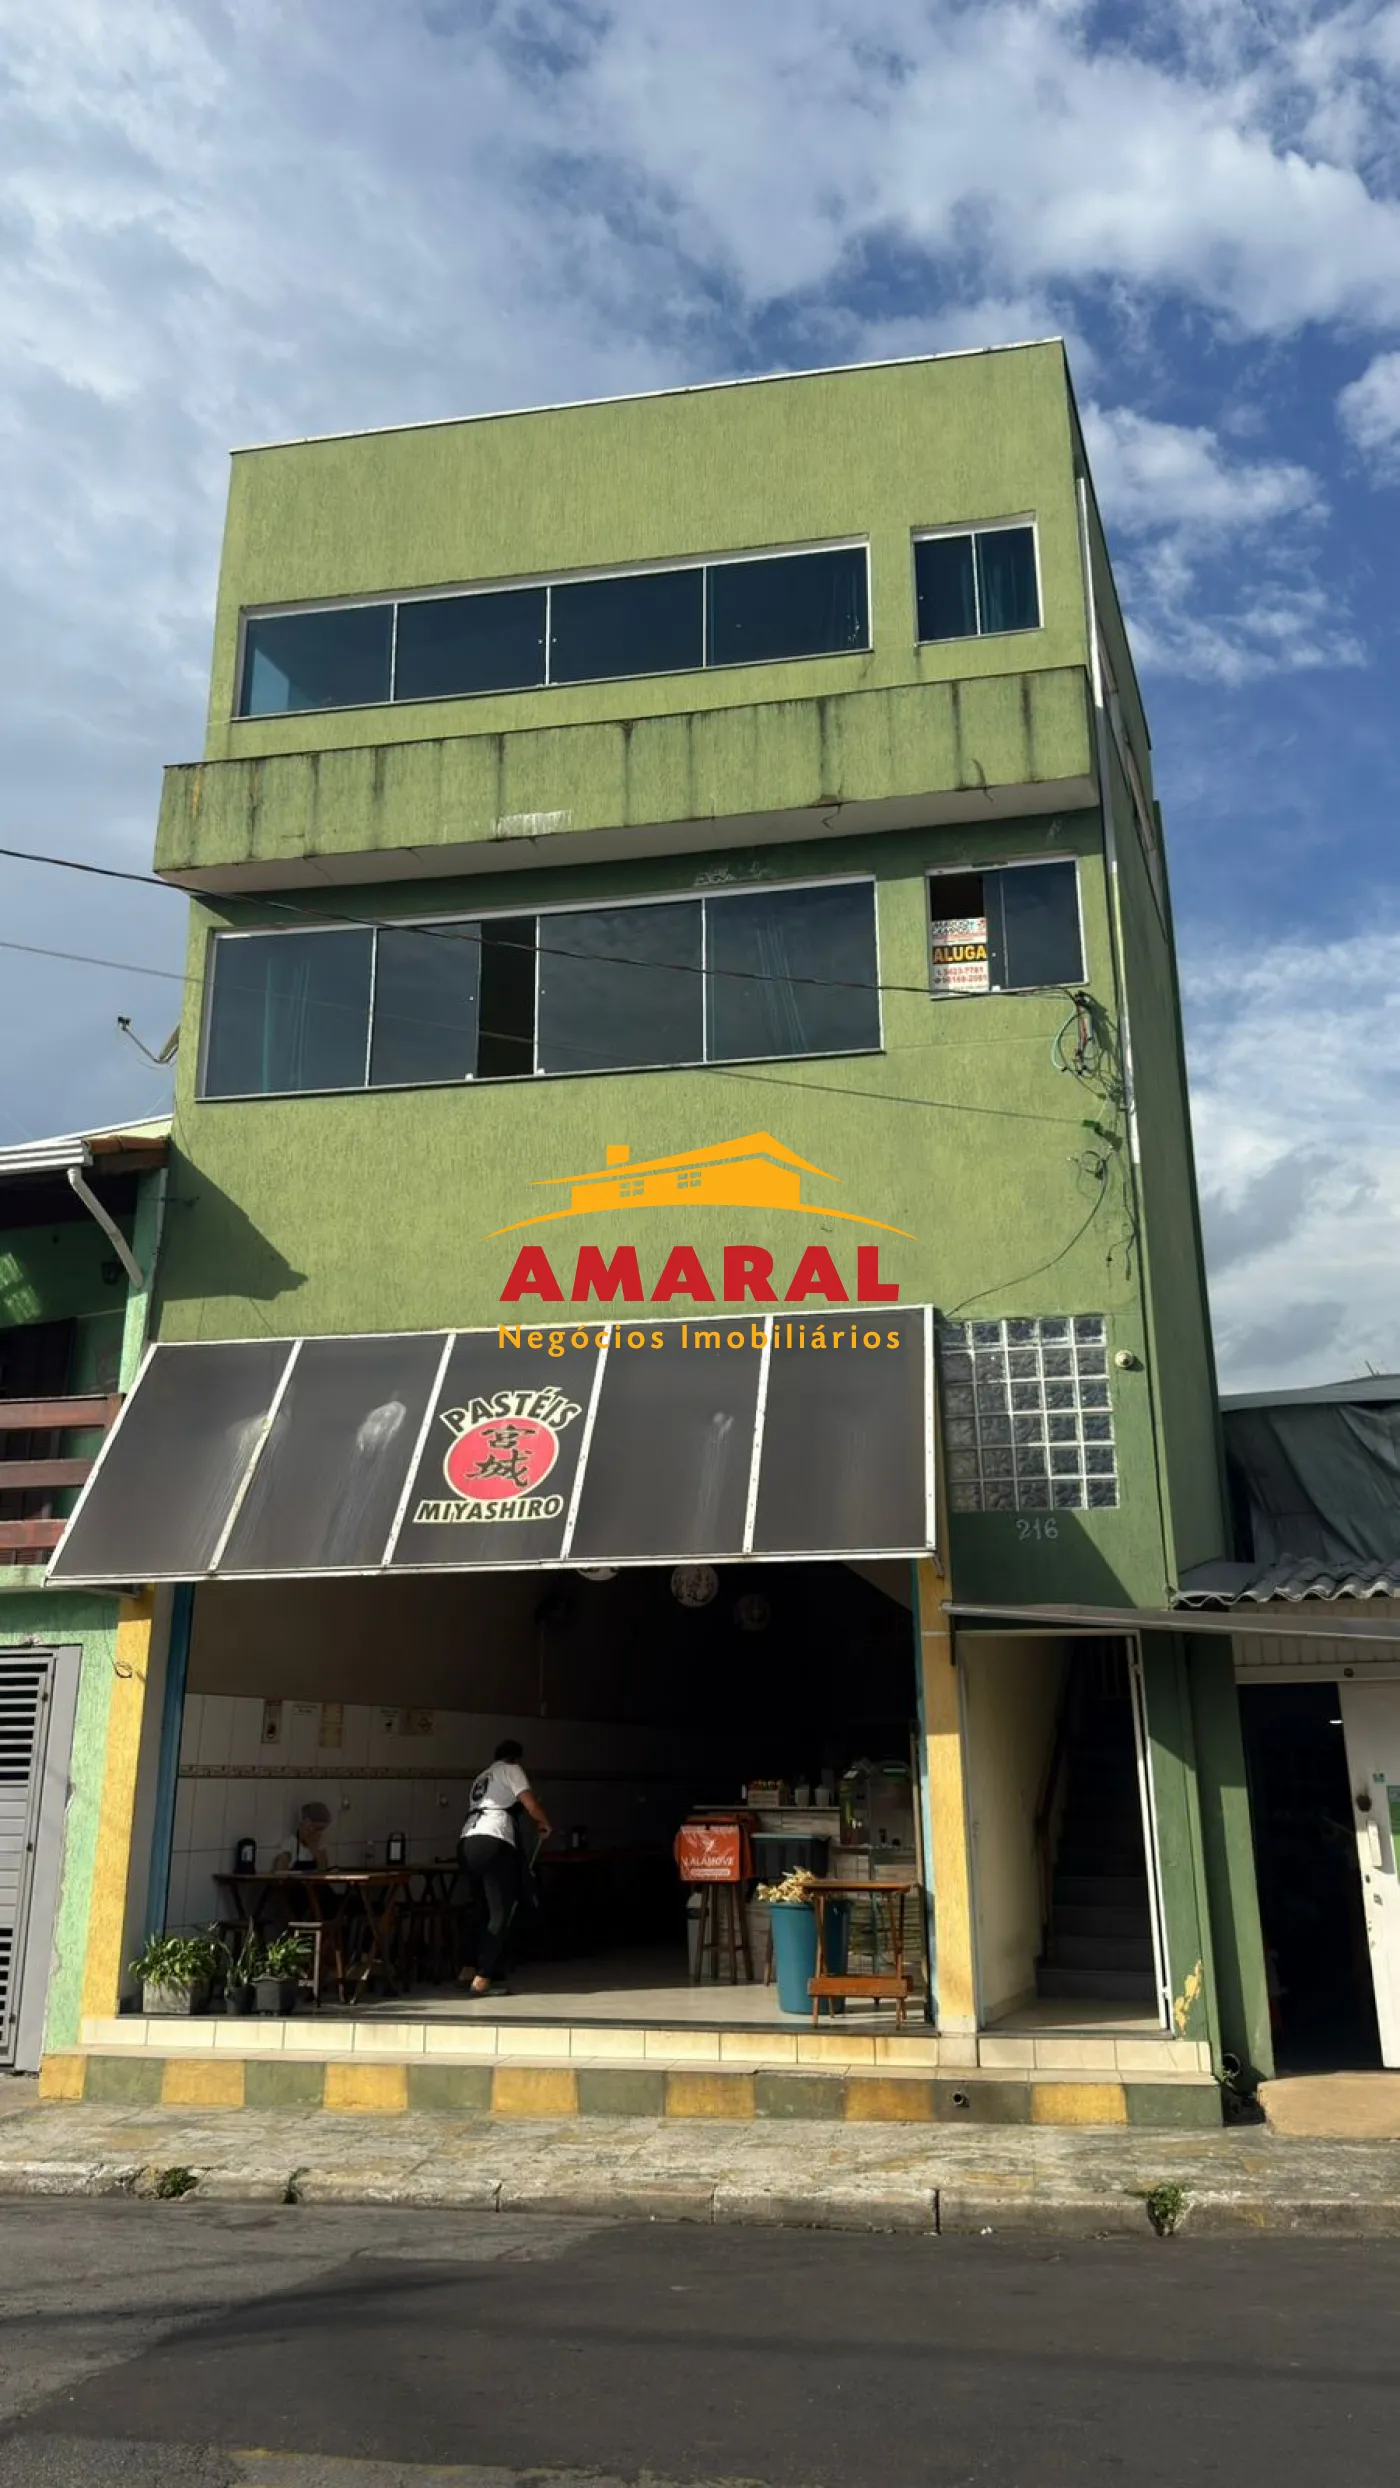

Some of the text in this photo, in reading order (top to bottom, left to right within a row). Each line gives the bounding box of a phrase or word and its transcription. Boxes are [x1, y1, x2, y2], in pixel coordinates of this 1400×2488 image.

[934, 945, 987, 962] ALUGA
[440, 1387, 581, 1436] PASTÉIS
[415, 1497, 562, 1522] MIYASHIRO
[1016, 1517, 1059, 1541] 216
